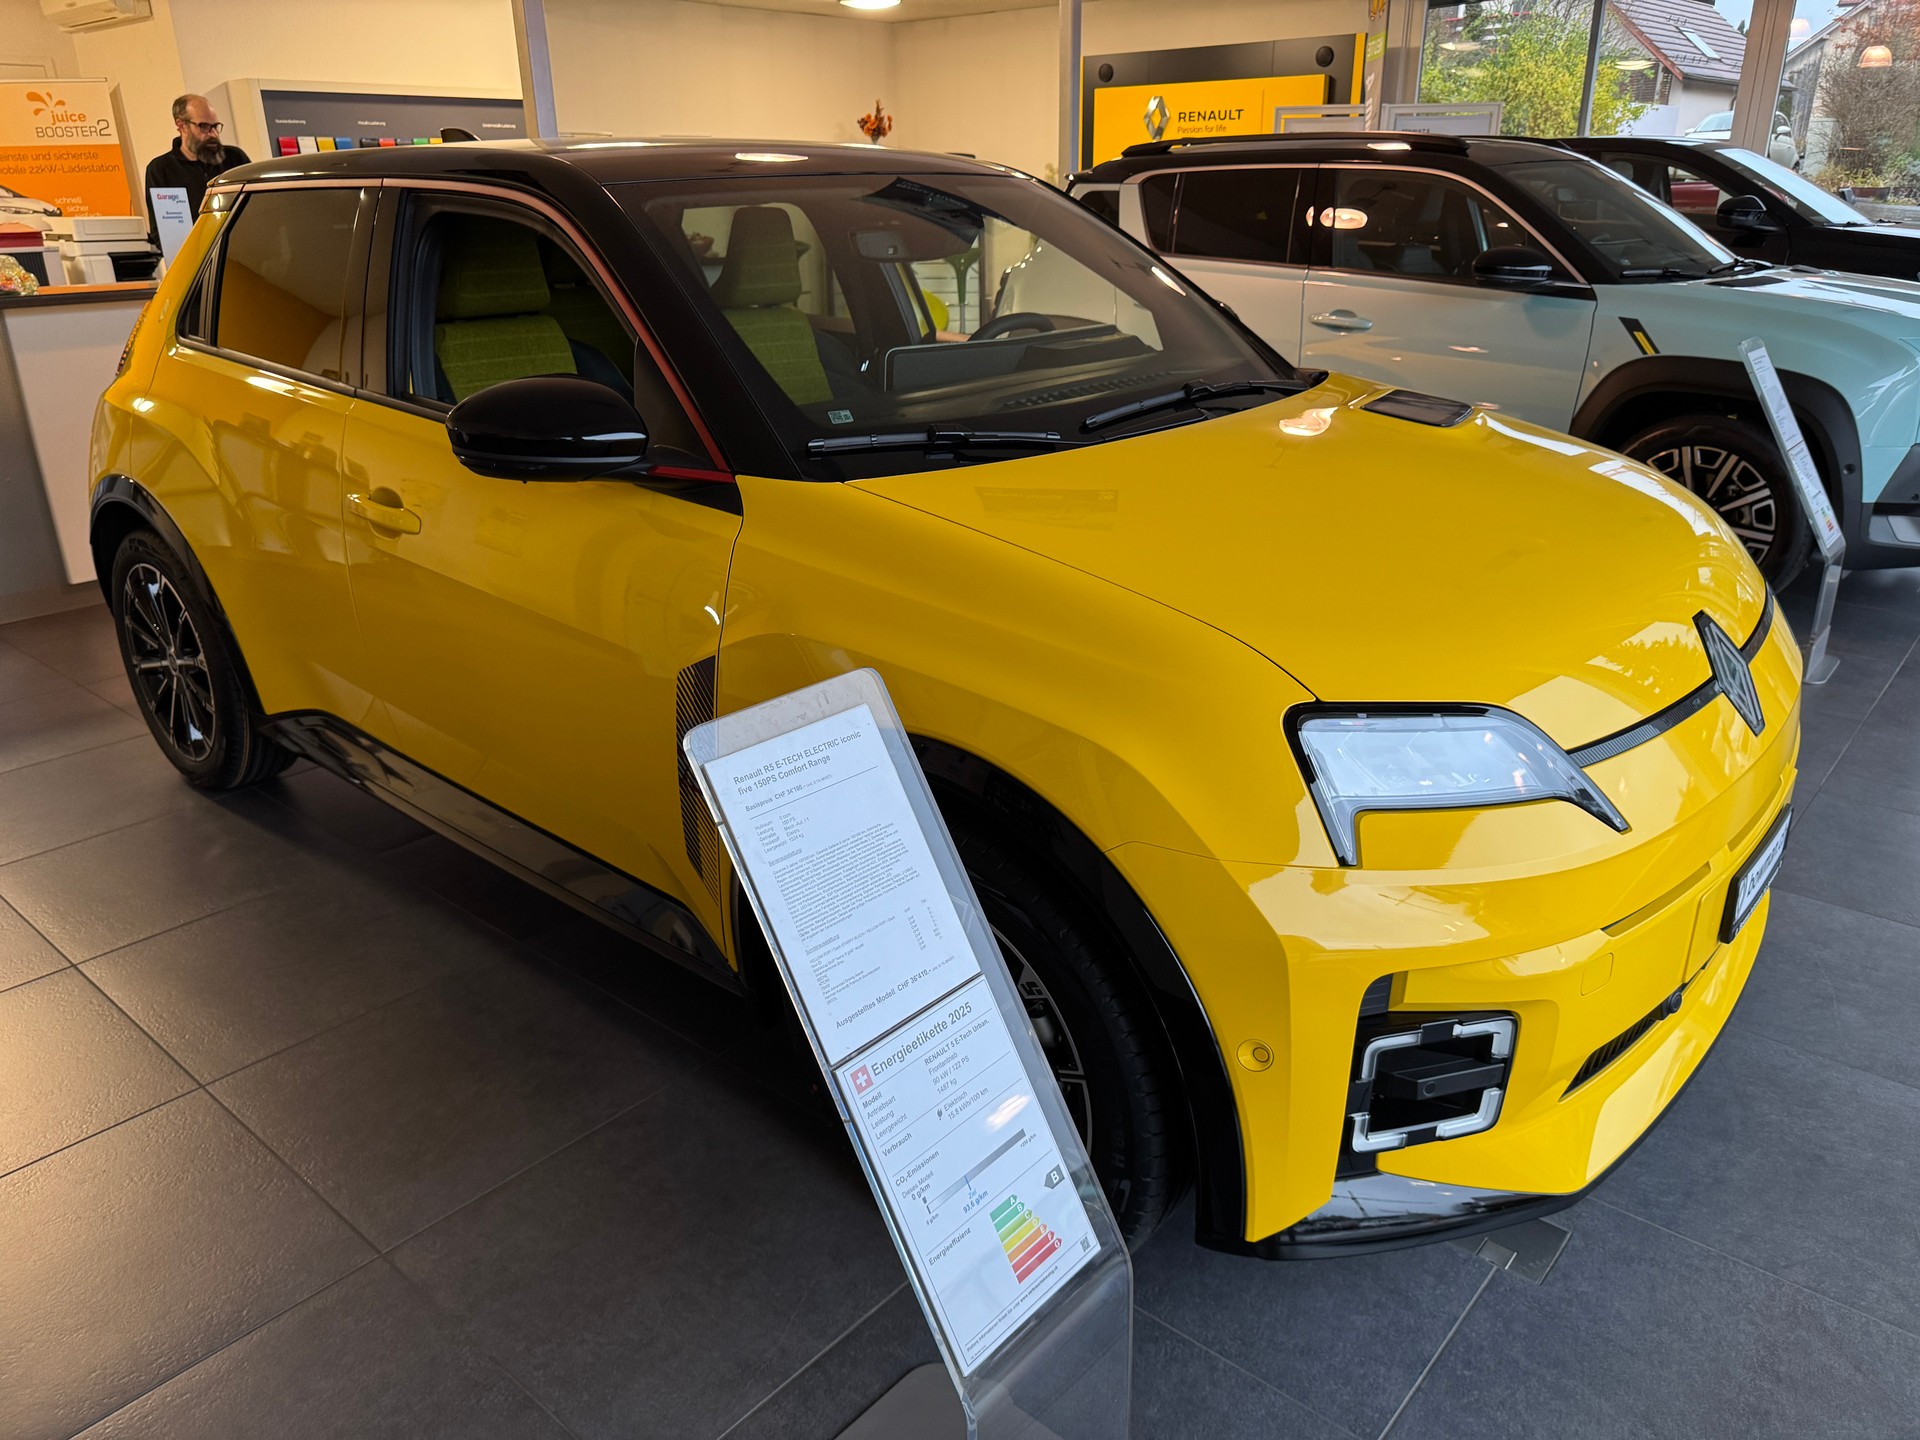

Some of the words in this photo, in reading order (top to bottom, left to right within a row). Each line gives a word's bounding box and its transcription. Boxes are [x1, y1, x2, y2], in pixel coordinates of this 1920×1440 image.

[51, 111, 87, 125] juice
[1178, 109, 1244, 122] RENAULT
[31, 151, 51, 160] und
[54, 149, 98, 160] sicherste
[732, 767, 763, 785] Renault
[762, 762, 775, 773] R5
[774, 751, 804, 769] E-TECH
[803, 737, 840, 758] ELECTRIC
[839, 729, 862, 744] iconic
[737, 783, 753, 795] five
[752, 773, 778, 789] 150PS
[777, 762, 808, 780] Comfort
[807, 753, 831, 769] Range
[744, 796, 773, 812] Basispreis
[773, 790, 786, 800] CHF
[834, 999, 877, 1030] Ausgestelltes
[875, 987, 896, 1005] Modell
[896, 979, 910, 991] CHF
[870, 1017, 949, 1079] Energieetikette
[947, 1001, 972, 1024] 2025
[861, 1090, 882, 1109] Modell
[923, 1043, 951, 1066] RENAULT
[950, 1040, 955, 1048] 5
[954, 1028, 973, 1045] E-Tech
[865, 1094, 896, 1119] Antriebsart
[928, 1050, 958, 1075] Frontantrieb
[870, 1108, 895, 1131] Leistung
[932, 1075, 940, 1085] 90
[939, 1068, 949, 1080] kW
[951, 1060, 961, 1072] 122
[960, 1054, 970, 1065] PS
[874, 1112, 908, 1141] Leergewicht
[936, 1081, 950, 1095] 1487
[949, 1076, 957, 1087] kg
[947, 1107, 960, 1120] 15.8
[958, 1091, 981, 1112] kWh/100
[979, 1085, 988, 1096] km
[882, 1131, 912, 1158] Verbrauch
[943, 1089, 967, 1111] Elektrisch
[901, 1181, 918, 1199] Dieses
[917, 1169, 934, 1186] Modell
[1050, 1169, 1059, 1184] B
[910, 1192, 916, 1201] 0
[915, 1181, 931, 1198] g/km
[967, 1187, 977, 1200] Ziel
[973, 1188, 989, 1206] g/km
[1008, 1195, 1015, 1205] A
[1016, 1202, 1023, 1212] B
[1024, 1210, 1030, 1220] C
[1031, 1217, 1038, 1227] D
[1039, 1224, 1045, 1234] E
[928, 1226, 971, 1266] Energieeffizienz
[1047, 1231, 1053, 1241] F
[1053, 1238, 1060, 1248] G
